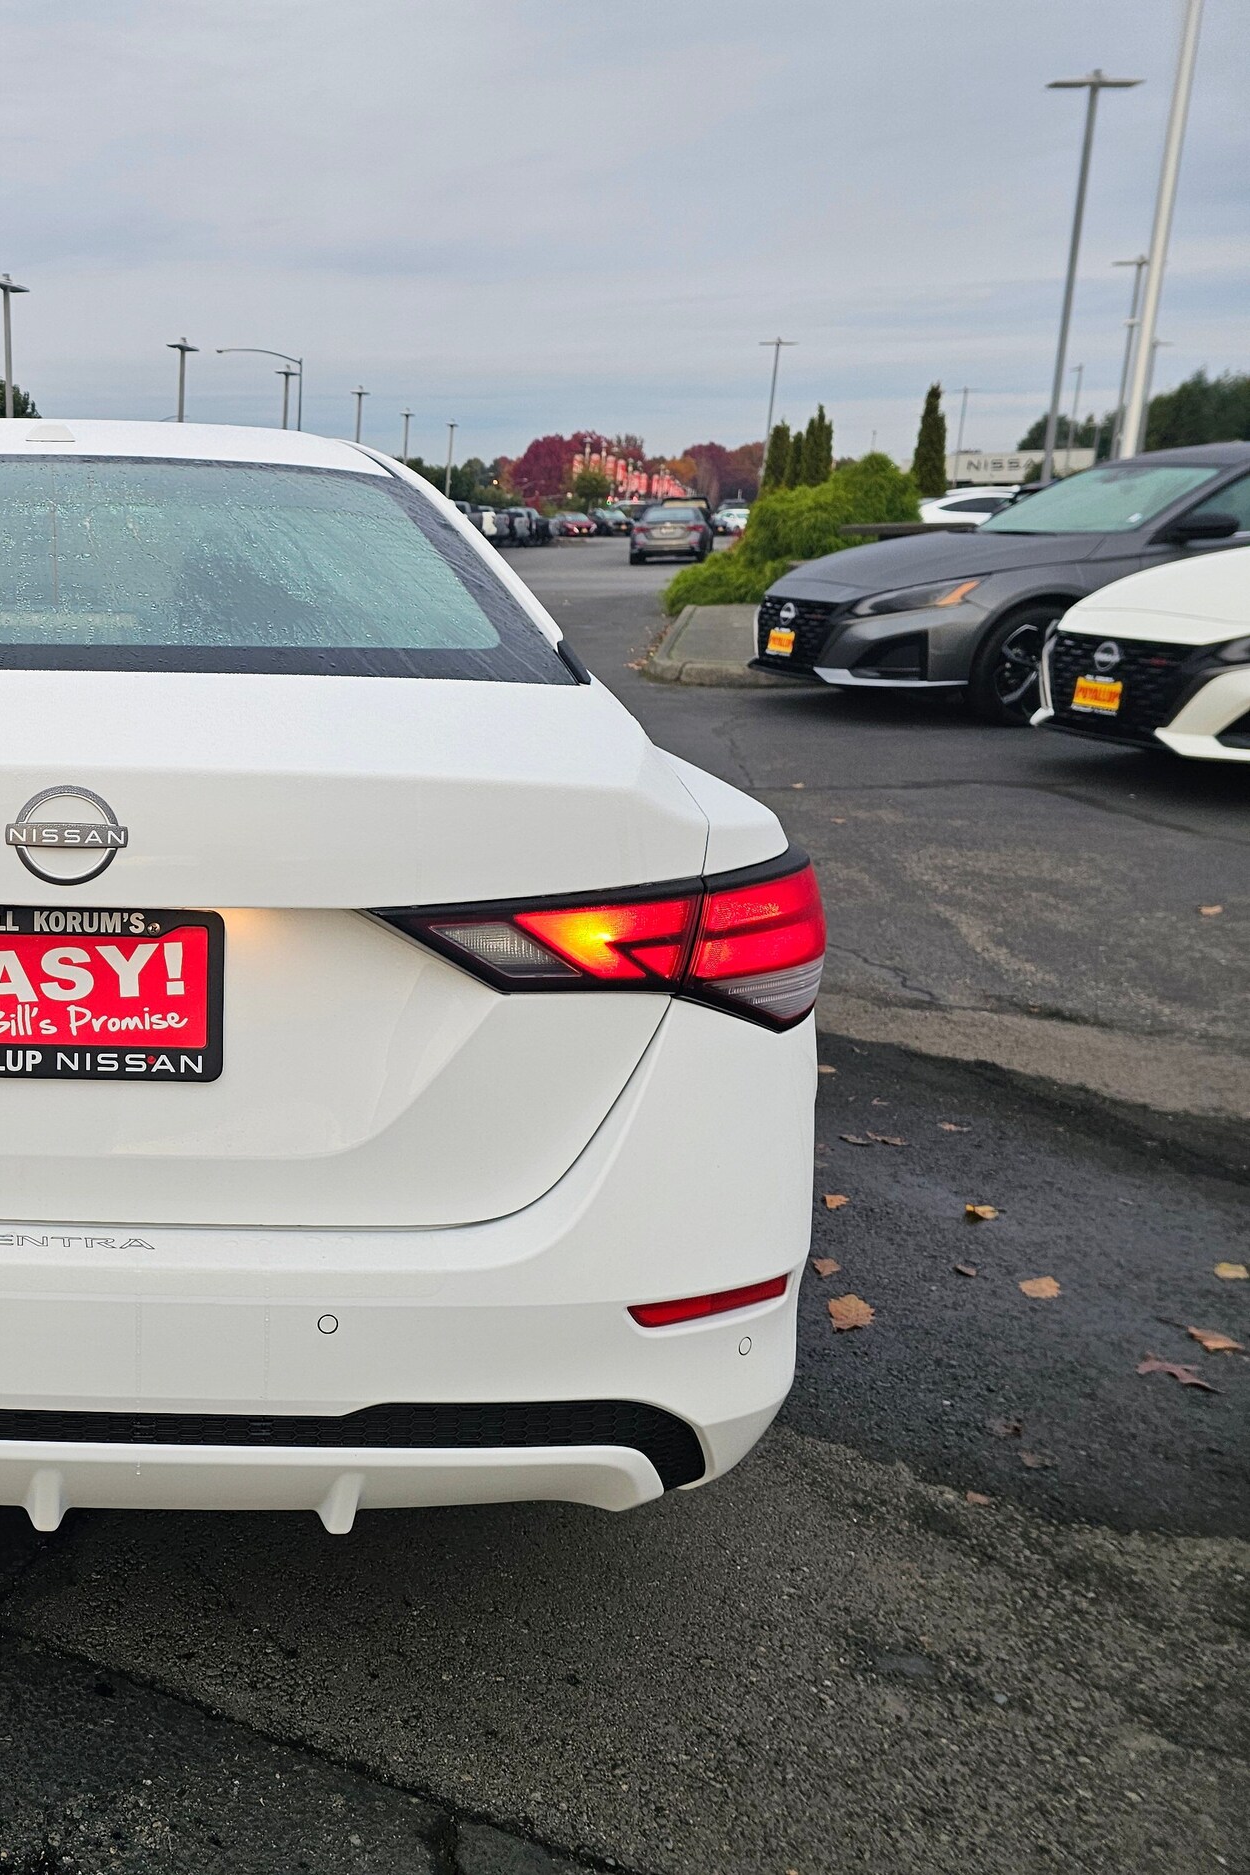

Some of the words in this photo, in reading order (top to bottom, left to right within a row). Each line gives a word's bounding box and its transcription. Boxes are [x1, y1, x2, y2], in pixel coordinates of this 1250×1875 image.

[966, 457, 1053, 472] NISSA
[8, 827, 126, 845] NISSAN
[33, 911, 145, 934] KORUM'S
[66, 1004, 189, 1038] Promise
[56, 1051, 203, 1074] NISSAN
